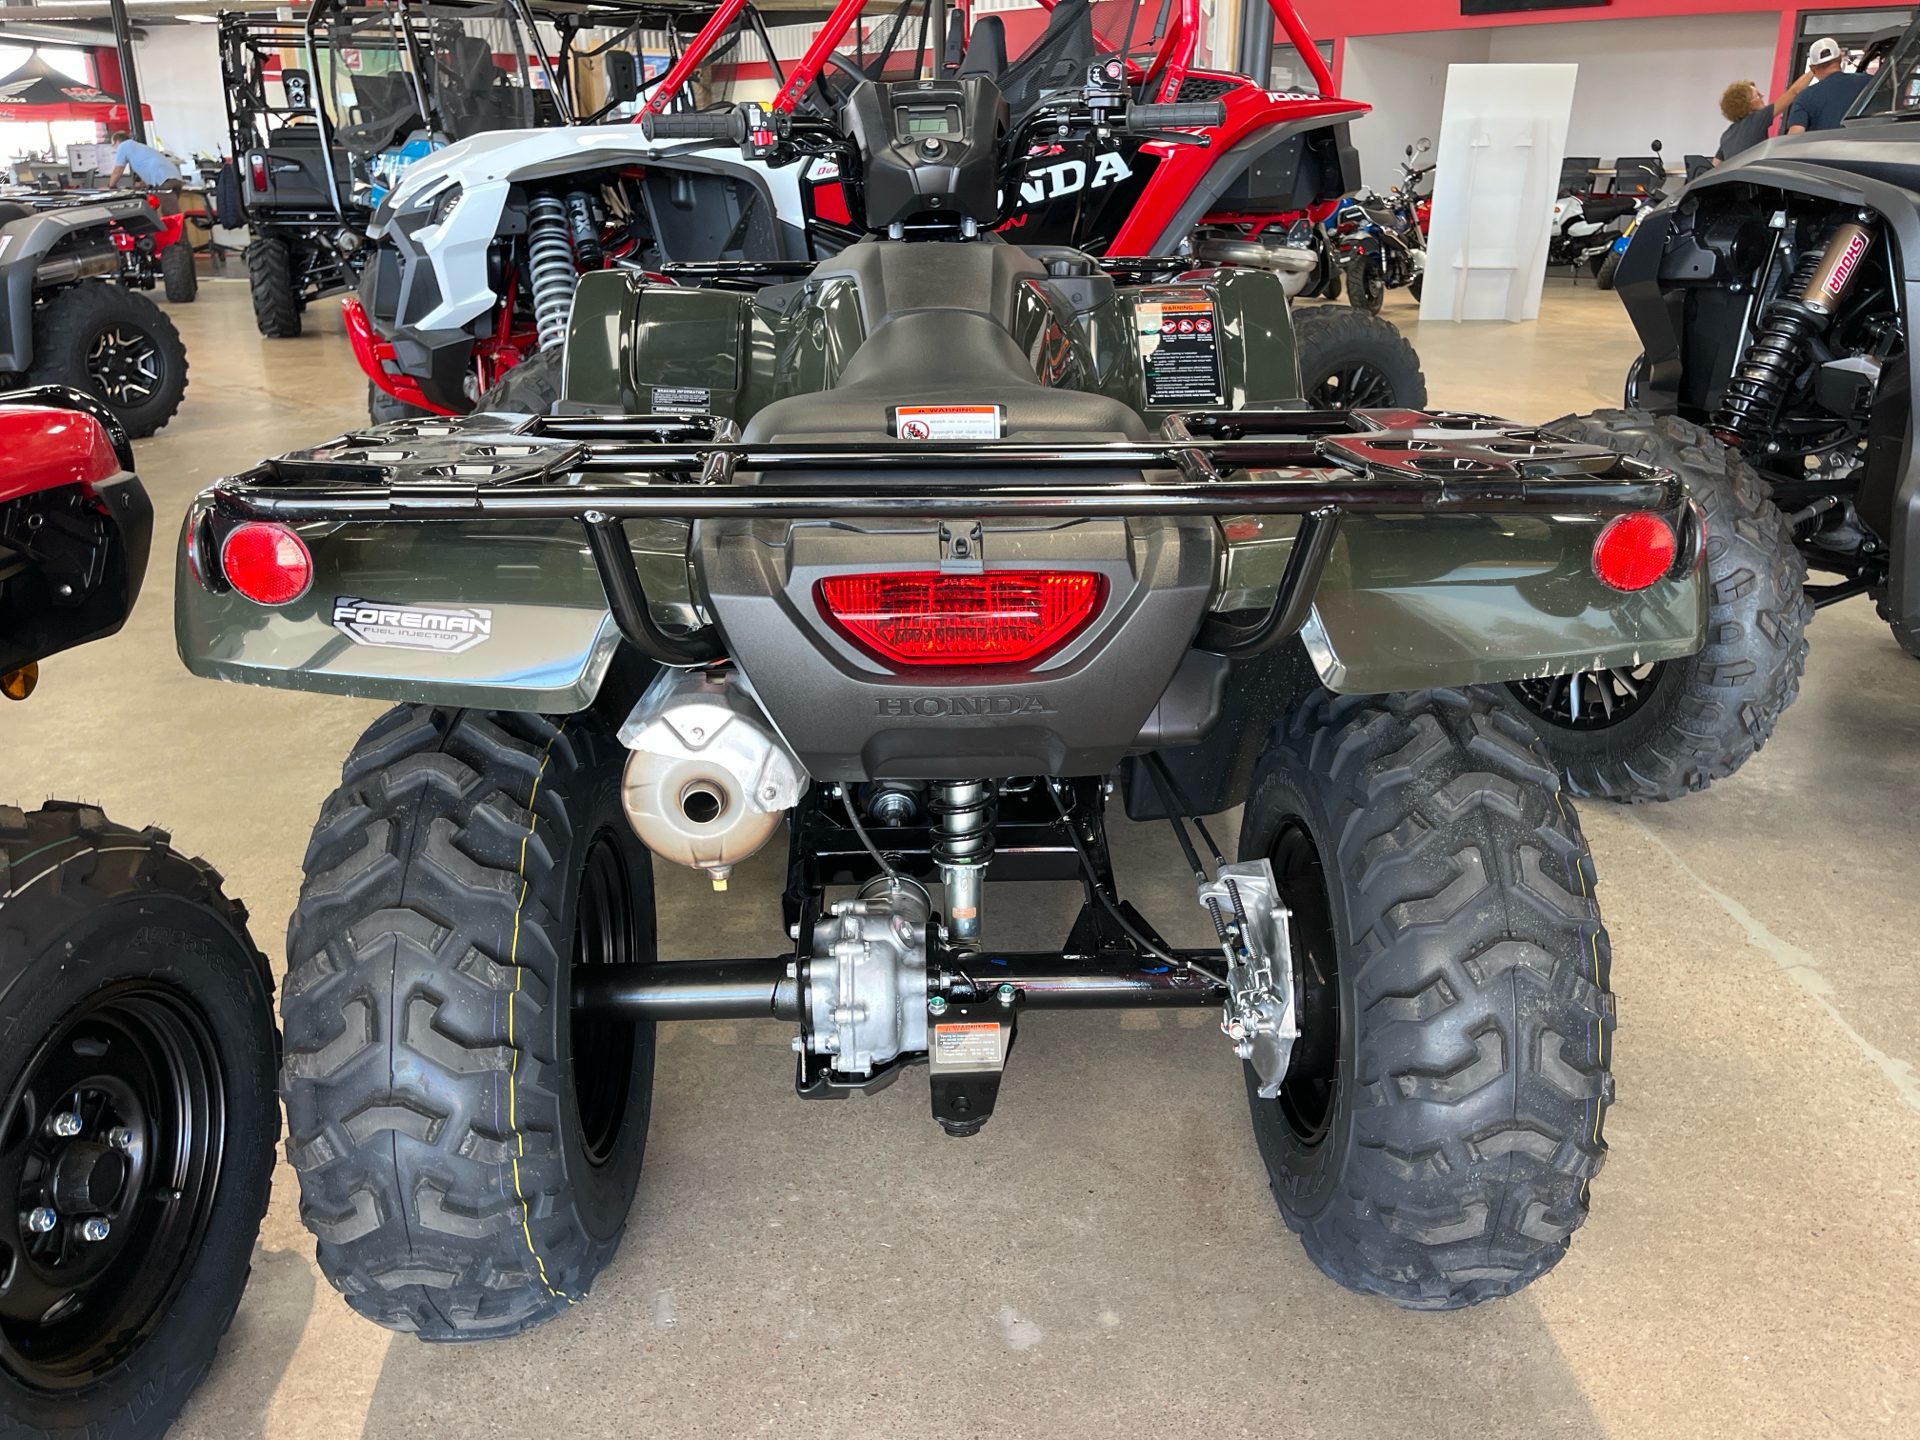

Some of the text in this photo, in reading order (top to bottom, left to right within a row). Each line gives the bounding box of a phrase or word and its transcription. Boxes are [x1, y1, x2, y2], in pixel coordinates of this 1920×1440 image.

[1265, 92, 1321, 103] 1000
[817, 166, 839, 175] Dua
[998, 152, 1133, 209] NDA
[1829, 235, 1864, 293] SHOWA
[333, 607, 491, 634] FOREMAN
[363, 627, 458, 641] FUEL INJECTION
[874, 694, 1058, 718] HONDA
